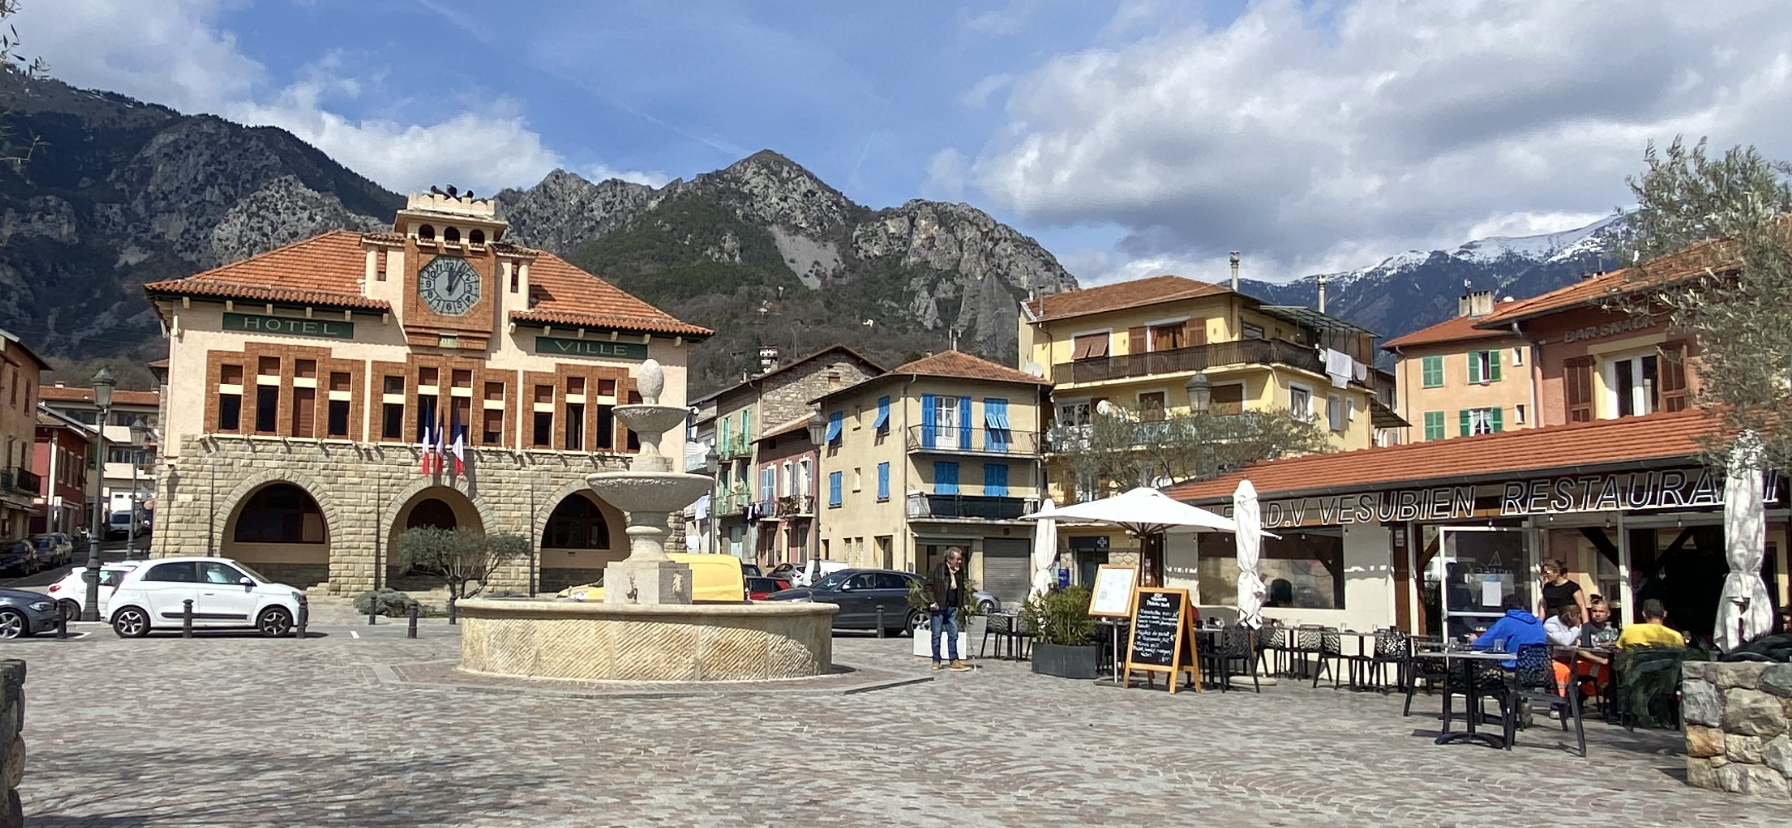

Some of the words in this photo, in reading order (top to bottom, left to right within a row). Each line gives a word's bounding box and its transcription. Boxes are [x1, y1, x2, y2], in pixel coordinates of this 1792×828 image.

[244, 317, 338, 335] HOTEL
[1563, 326, 1597, 343] BAR
[554, 340, 628, 356] VILLE
[1318, 486, 1476, 526] VESUBIEN
